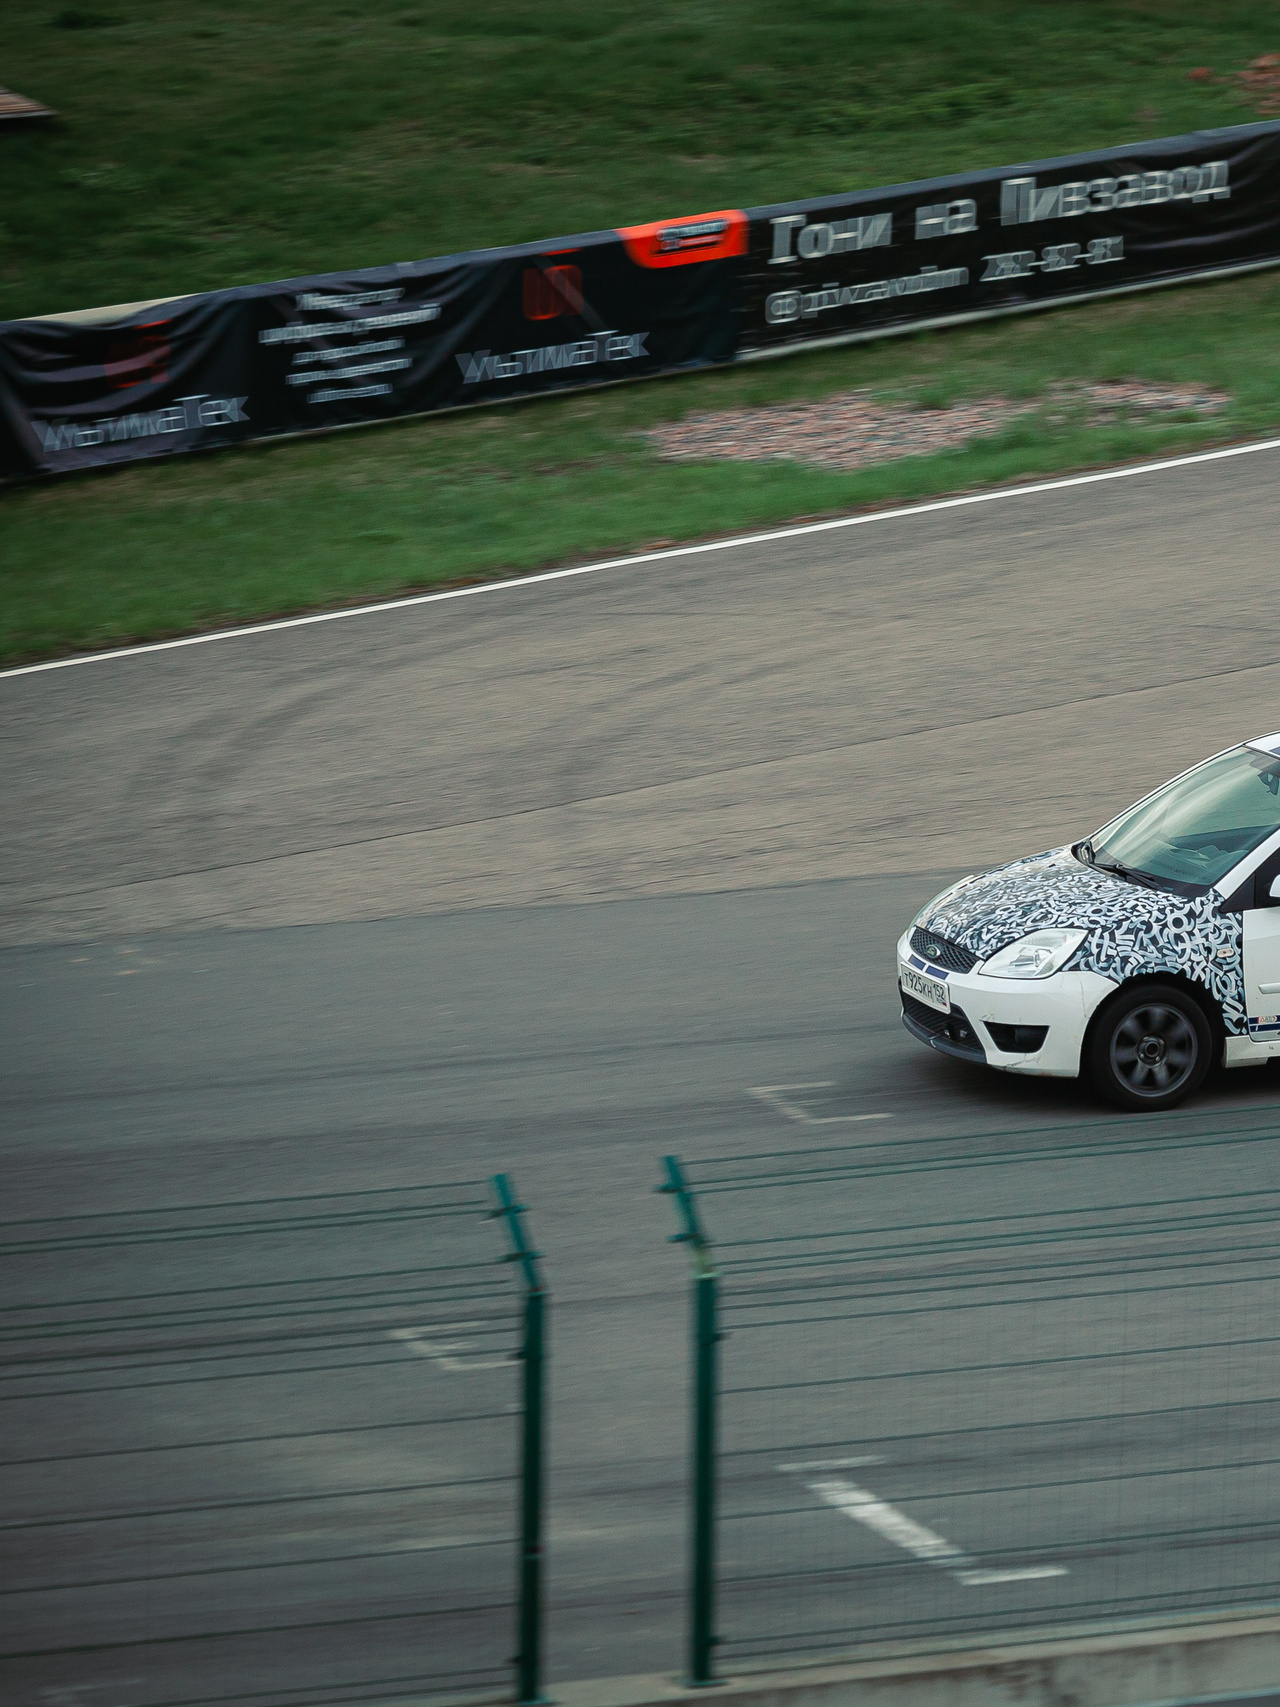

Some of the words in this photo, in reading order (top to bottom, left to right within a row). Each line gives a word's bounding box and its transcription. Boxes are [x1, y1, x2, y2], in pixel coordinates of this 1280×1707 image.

[767, 212, 893, 264] Гони
[914, 198, 979, 240] на
[1000, 160, 1231, 226] Пивзавод
